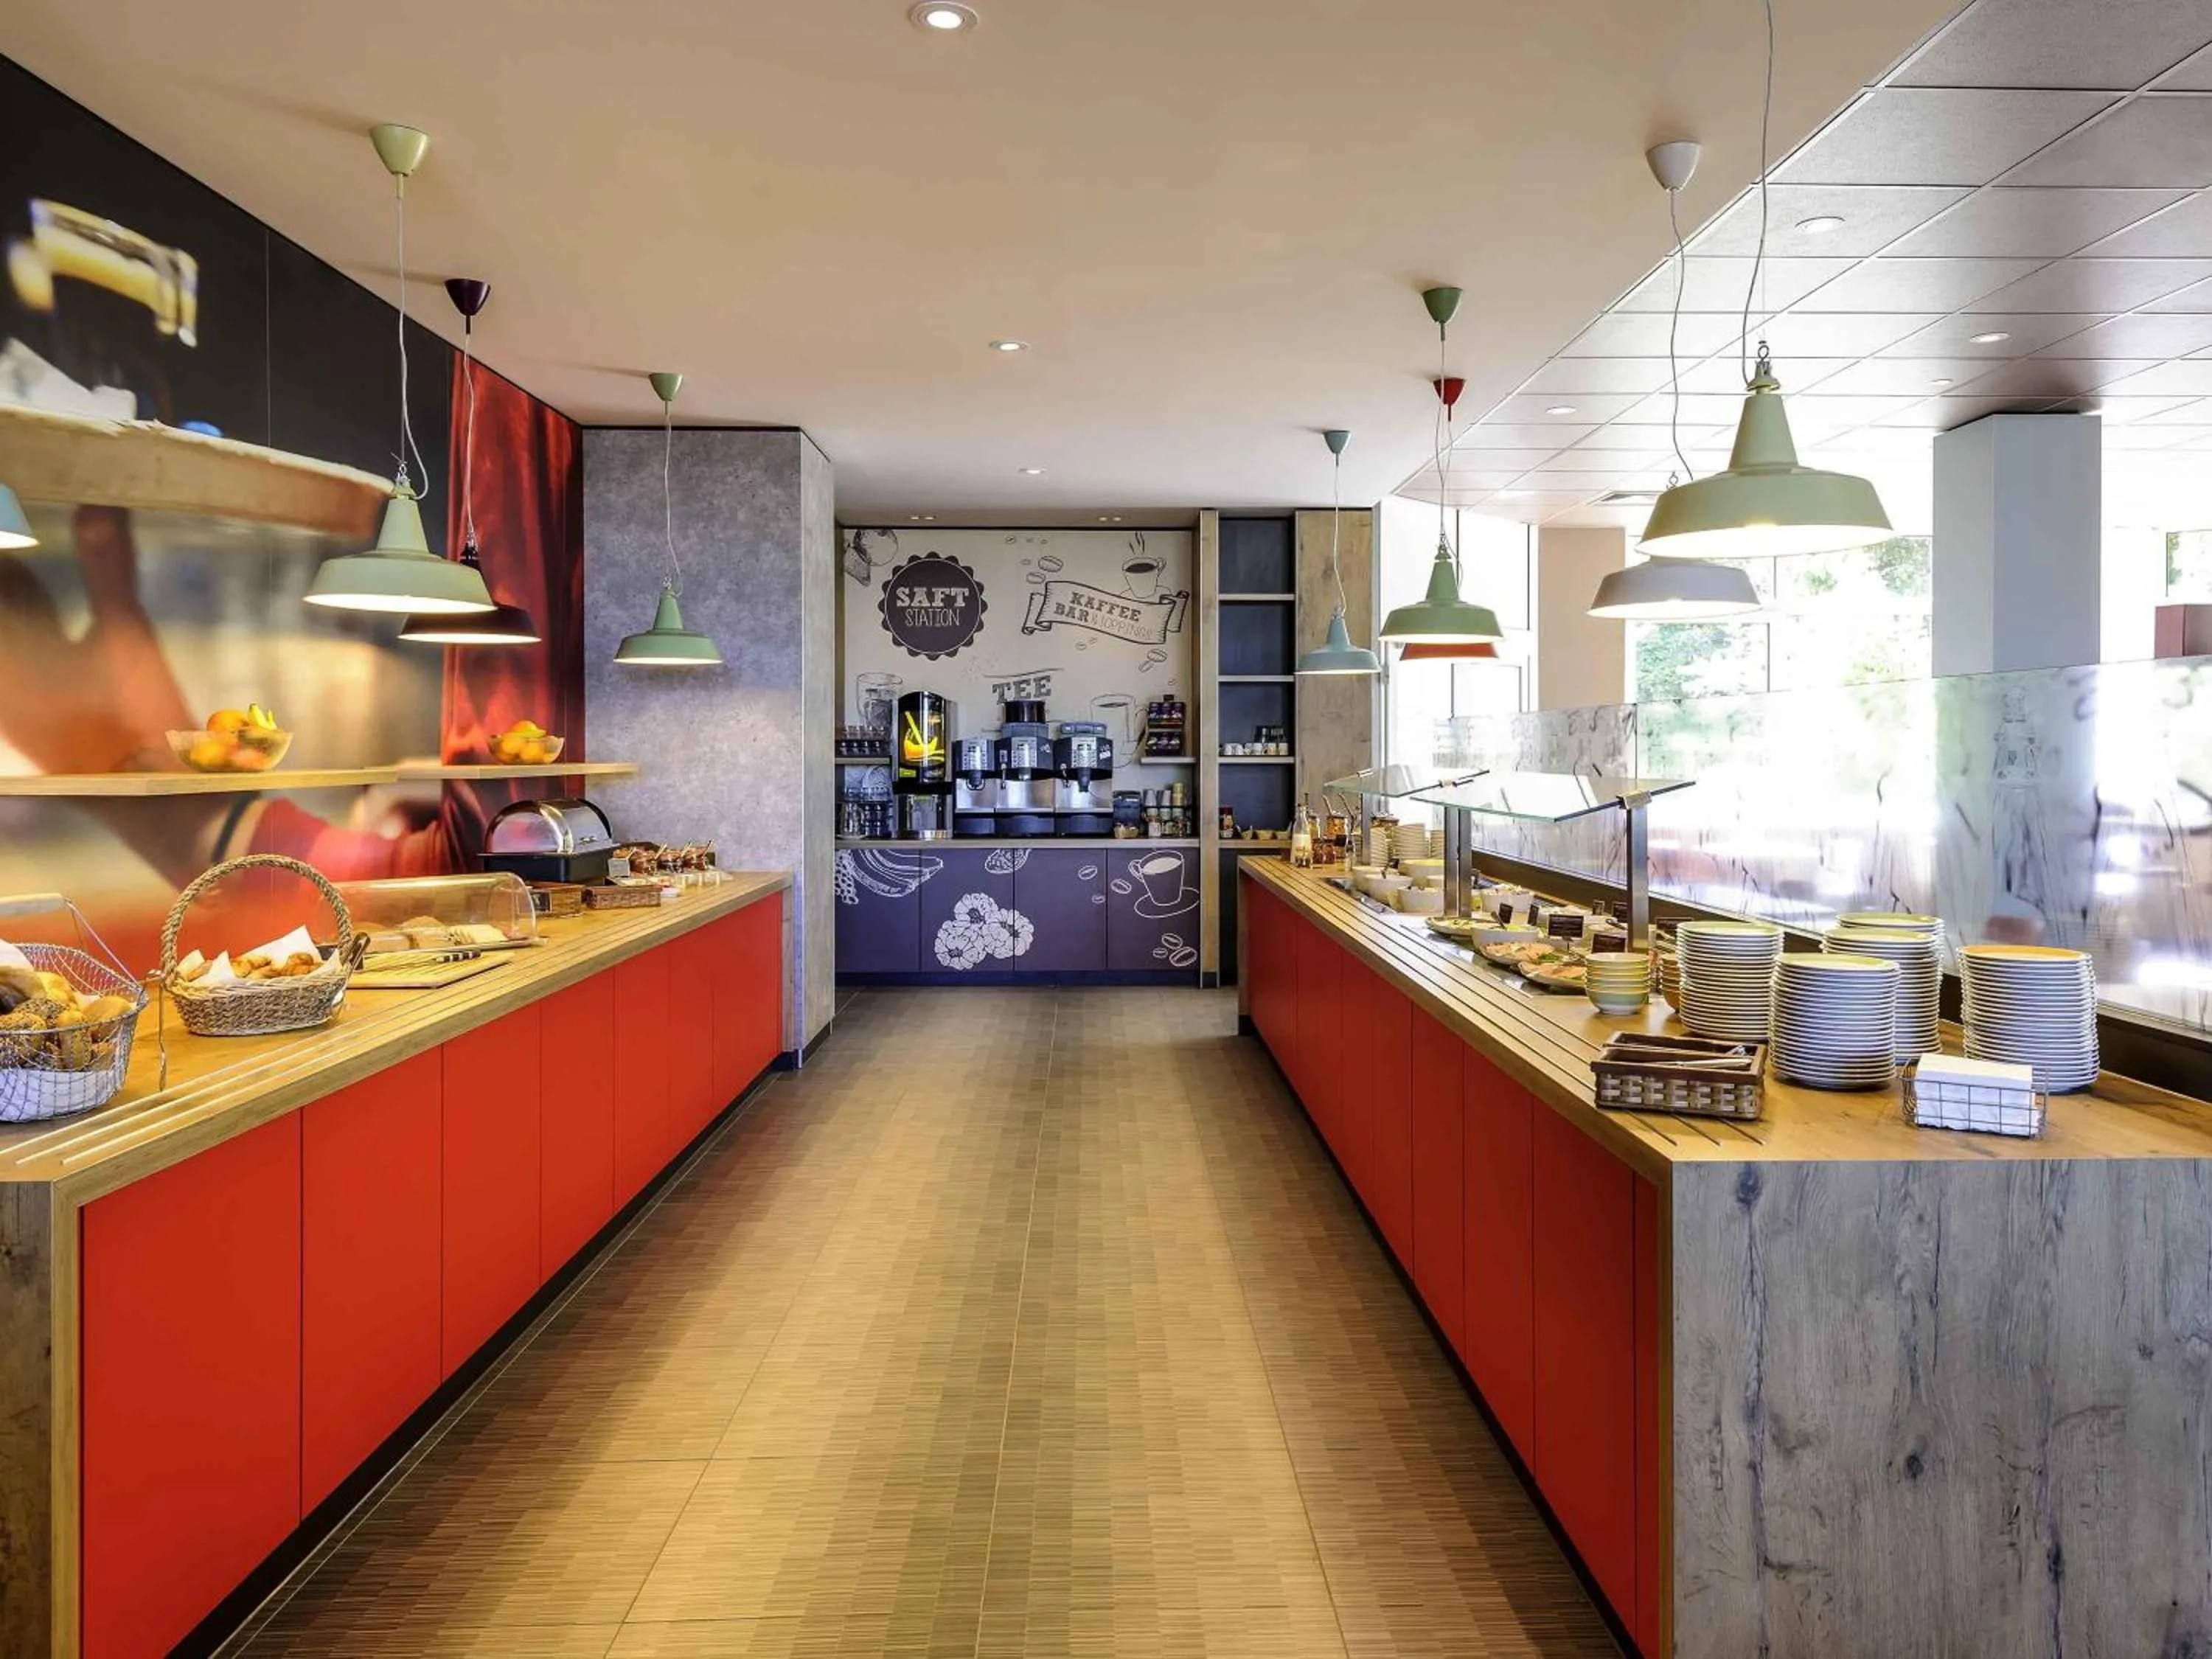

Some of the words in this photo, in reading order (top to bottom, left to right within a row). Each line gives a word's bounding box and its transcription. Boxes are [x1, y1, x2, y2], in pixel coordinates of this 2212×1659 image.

[896, 587, 970, 607] SAFT
[1069, 592, 1141, 622] KAFFEE
[905, 608, 960, 627] STATION
[1054, 602, 1090, 623] BAR
[992, 675, 1051, 705] TEE
